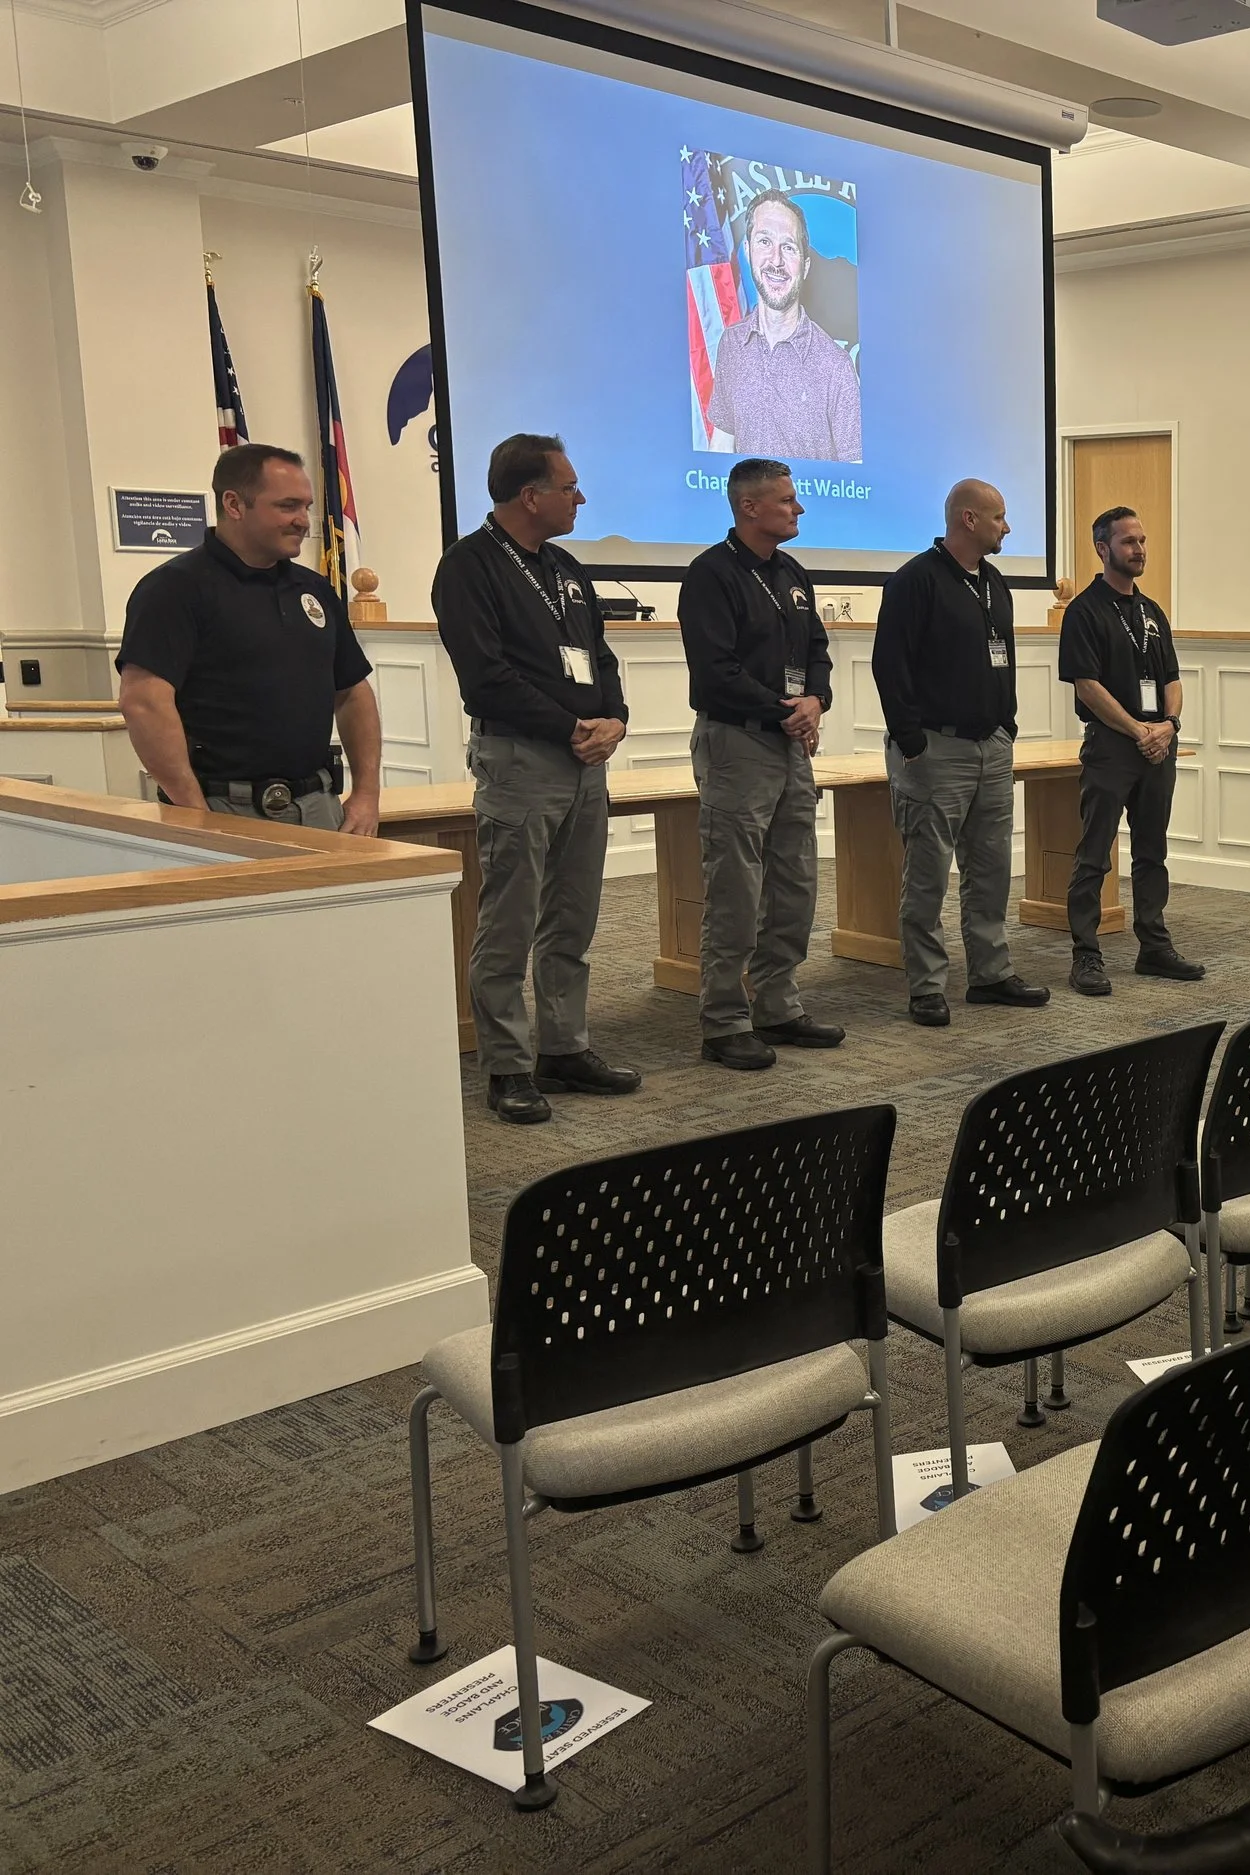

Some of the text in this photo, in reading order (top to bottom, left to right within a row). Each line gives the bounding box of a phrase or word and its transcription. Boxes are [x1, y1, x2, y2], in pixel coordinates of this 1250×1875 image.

[814, 478, 872, 500] Walder
[502, 541, 526, 569] POLICE
[539, 590, 562, 621] CASTLE
[917, 1464, 951, 1474] BADGE
[425, 1672, 496, 1713] PRESENTERS
[440, 1679, 504, 1718] AND BADGE
[455, 1685, 519, 1723] CHAPLAINS
[572, 1707, 628, 1743] RESERVED
